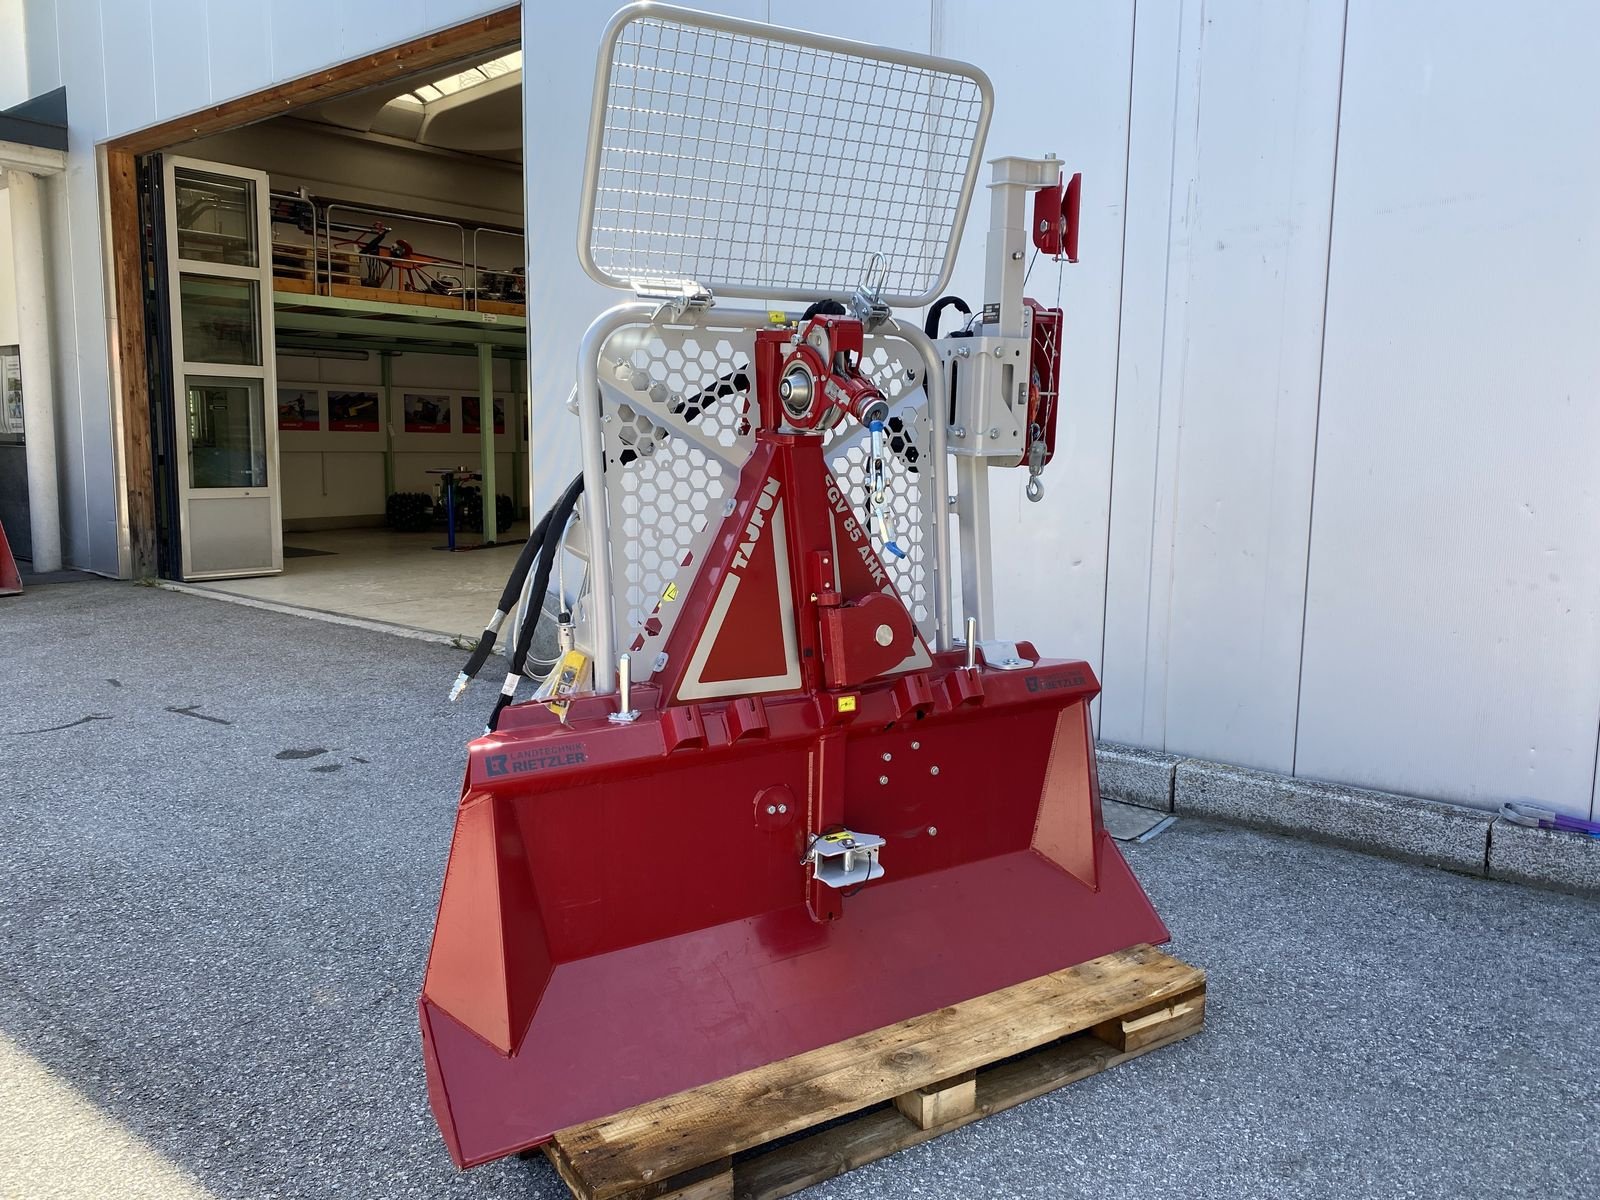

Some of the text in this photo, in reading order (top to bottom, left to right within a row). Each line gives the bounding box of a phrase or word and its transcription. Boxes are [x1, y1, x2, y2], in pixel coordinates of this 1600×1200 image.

[731, 476, 781, 569] TAJFUN
[843, 517, 862, 542] 85
[857, 545, 886, 587] AHK
[510, 742, 583, 759] LANDTECHNIK
[512, 752, 586, 773] RIETZLER
